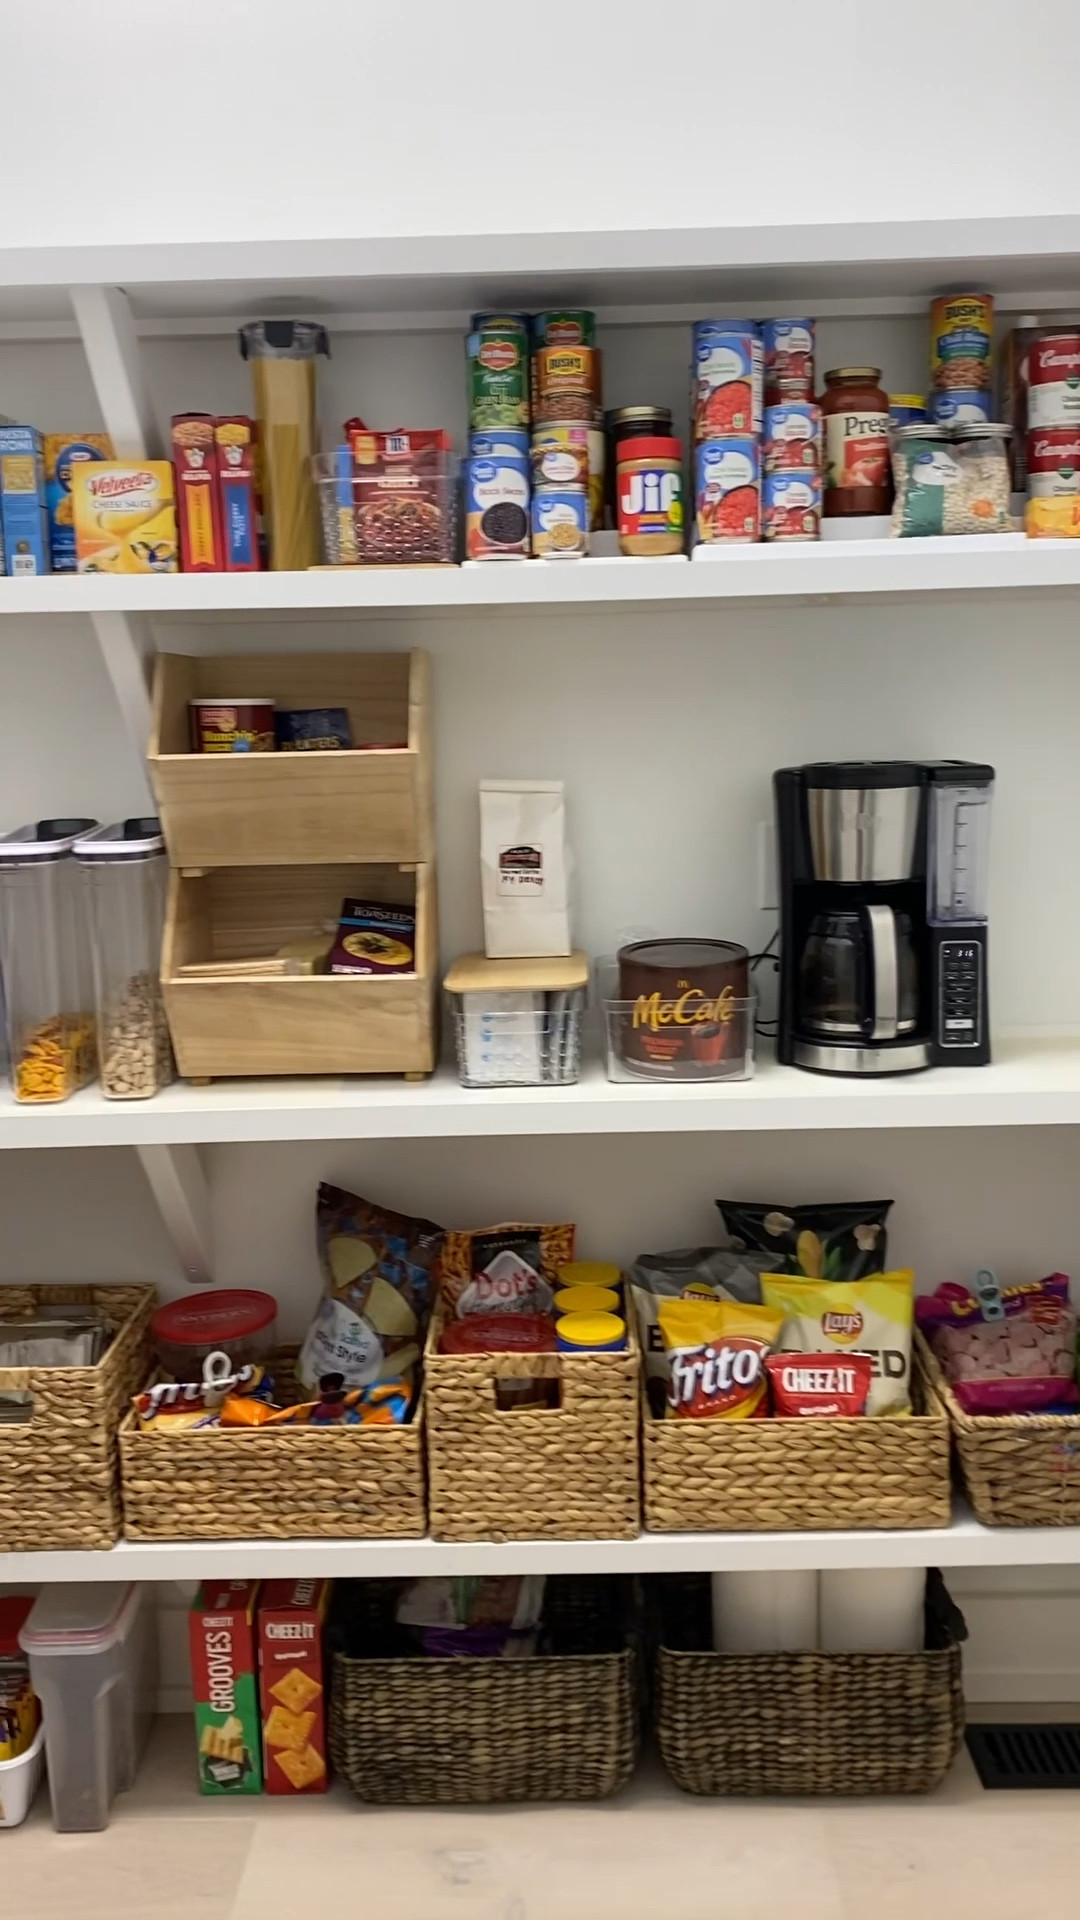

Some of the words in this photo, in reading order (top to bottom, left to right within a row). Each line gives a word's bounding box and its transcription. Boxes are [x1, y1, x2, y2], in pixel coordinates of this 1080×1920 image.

[844, 416, 888, 437] Preg
[89, 472, 155, 497] Velveeta
[621, 472, 681, 515] Jif
[475, 1268, 537, 1300] Dot's
[205, 1631, 236, 1713] GROOVES
